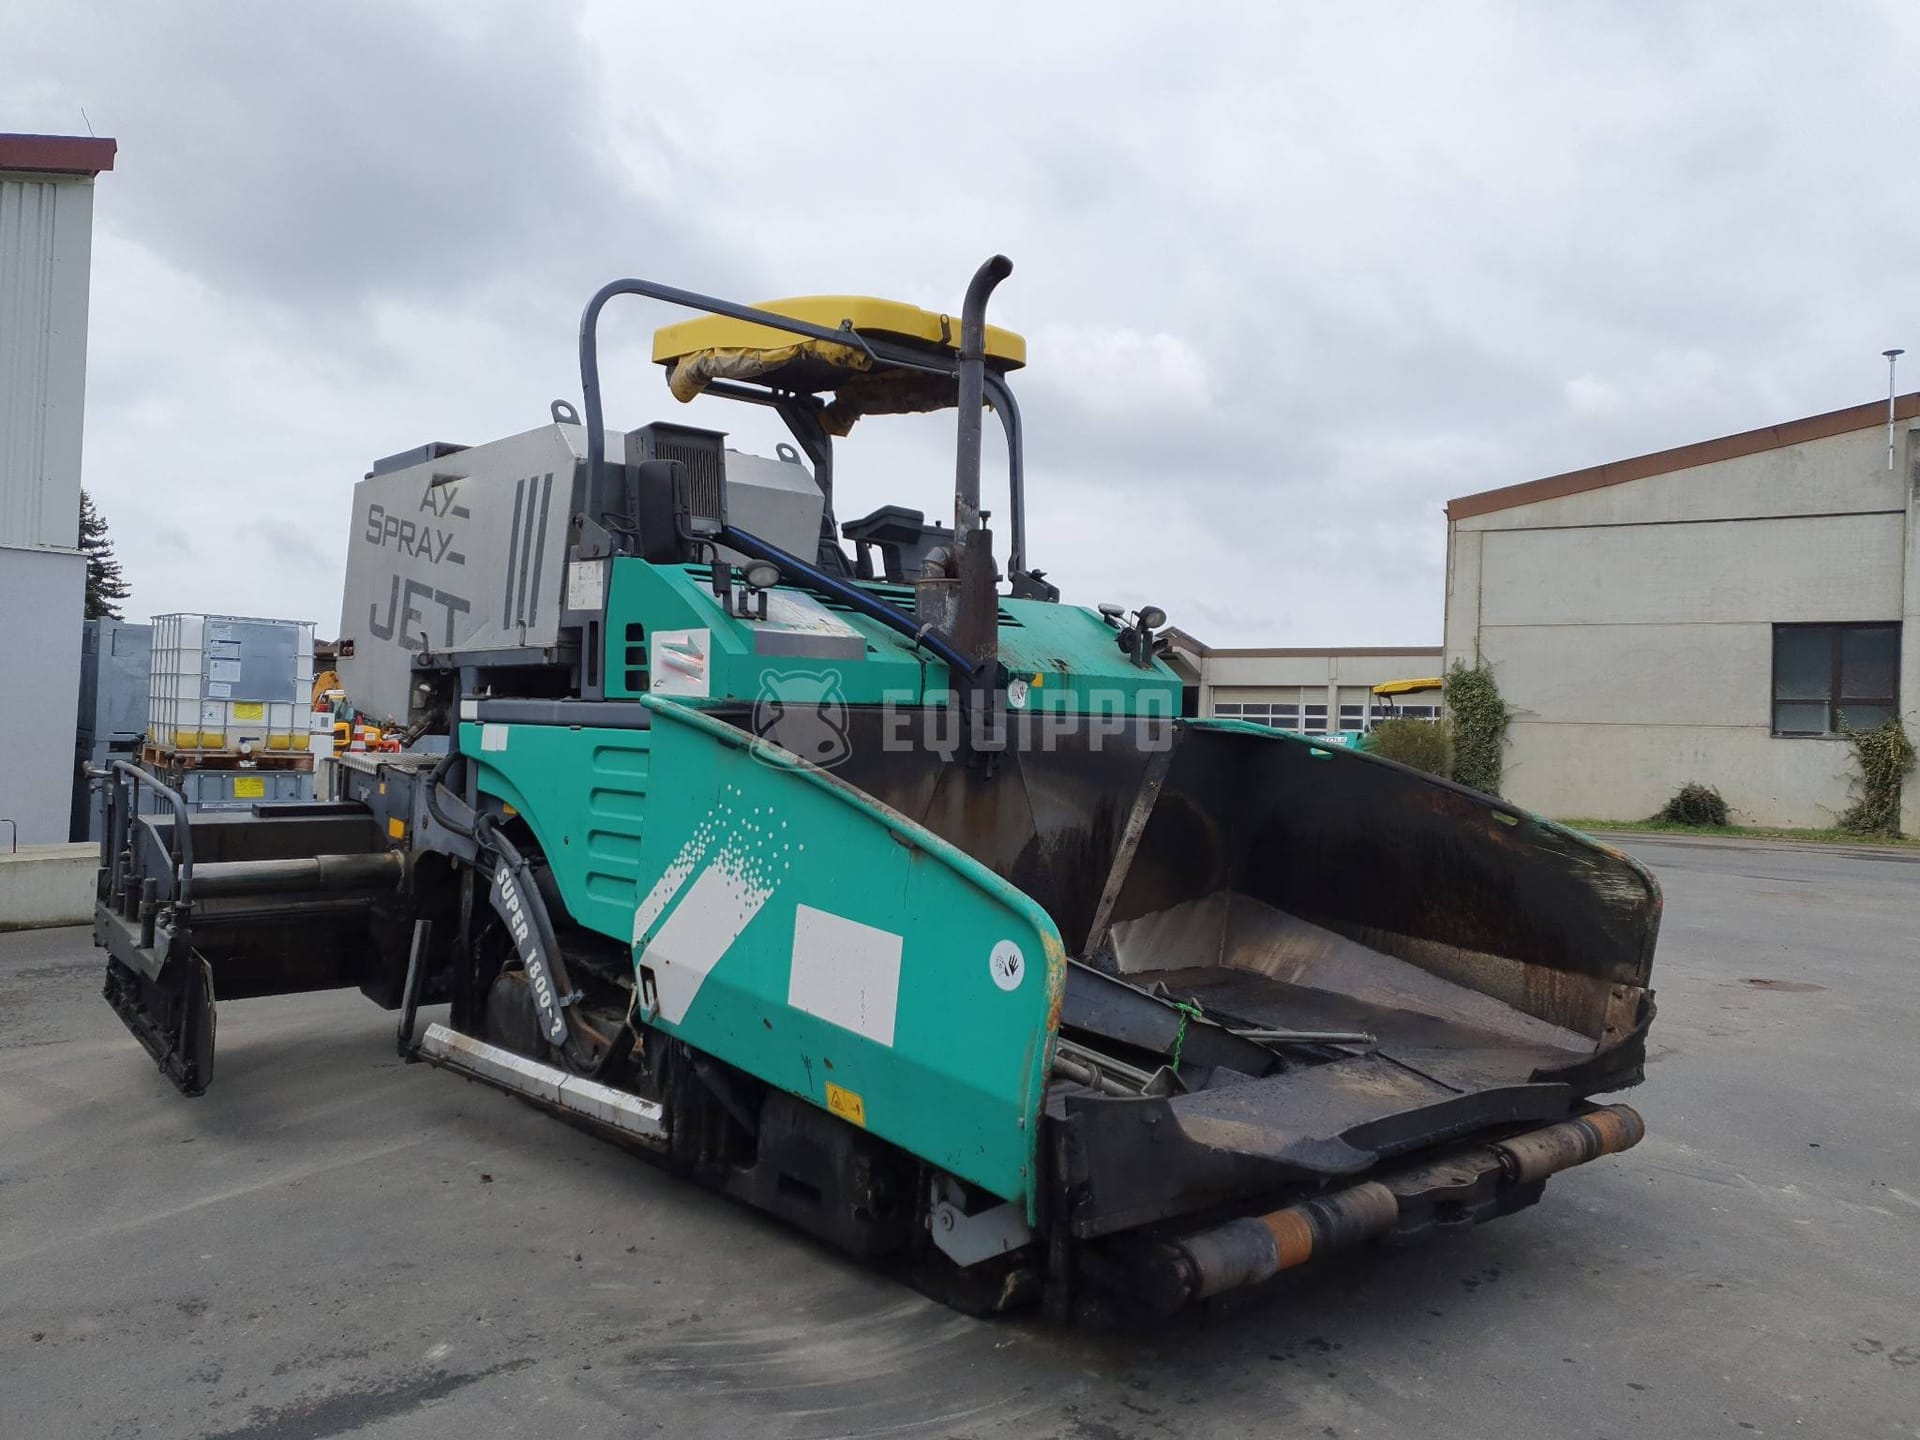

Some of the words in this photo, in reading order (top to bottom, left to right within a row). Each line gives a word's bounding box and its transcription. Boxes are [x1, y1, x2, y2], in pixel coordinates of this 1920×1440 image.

[370, 574, 471, 651] JET
[497, 868, 529, 945] SUPER
[526, 948, 562, 1036] 1800-2
